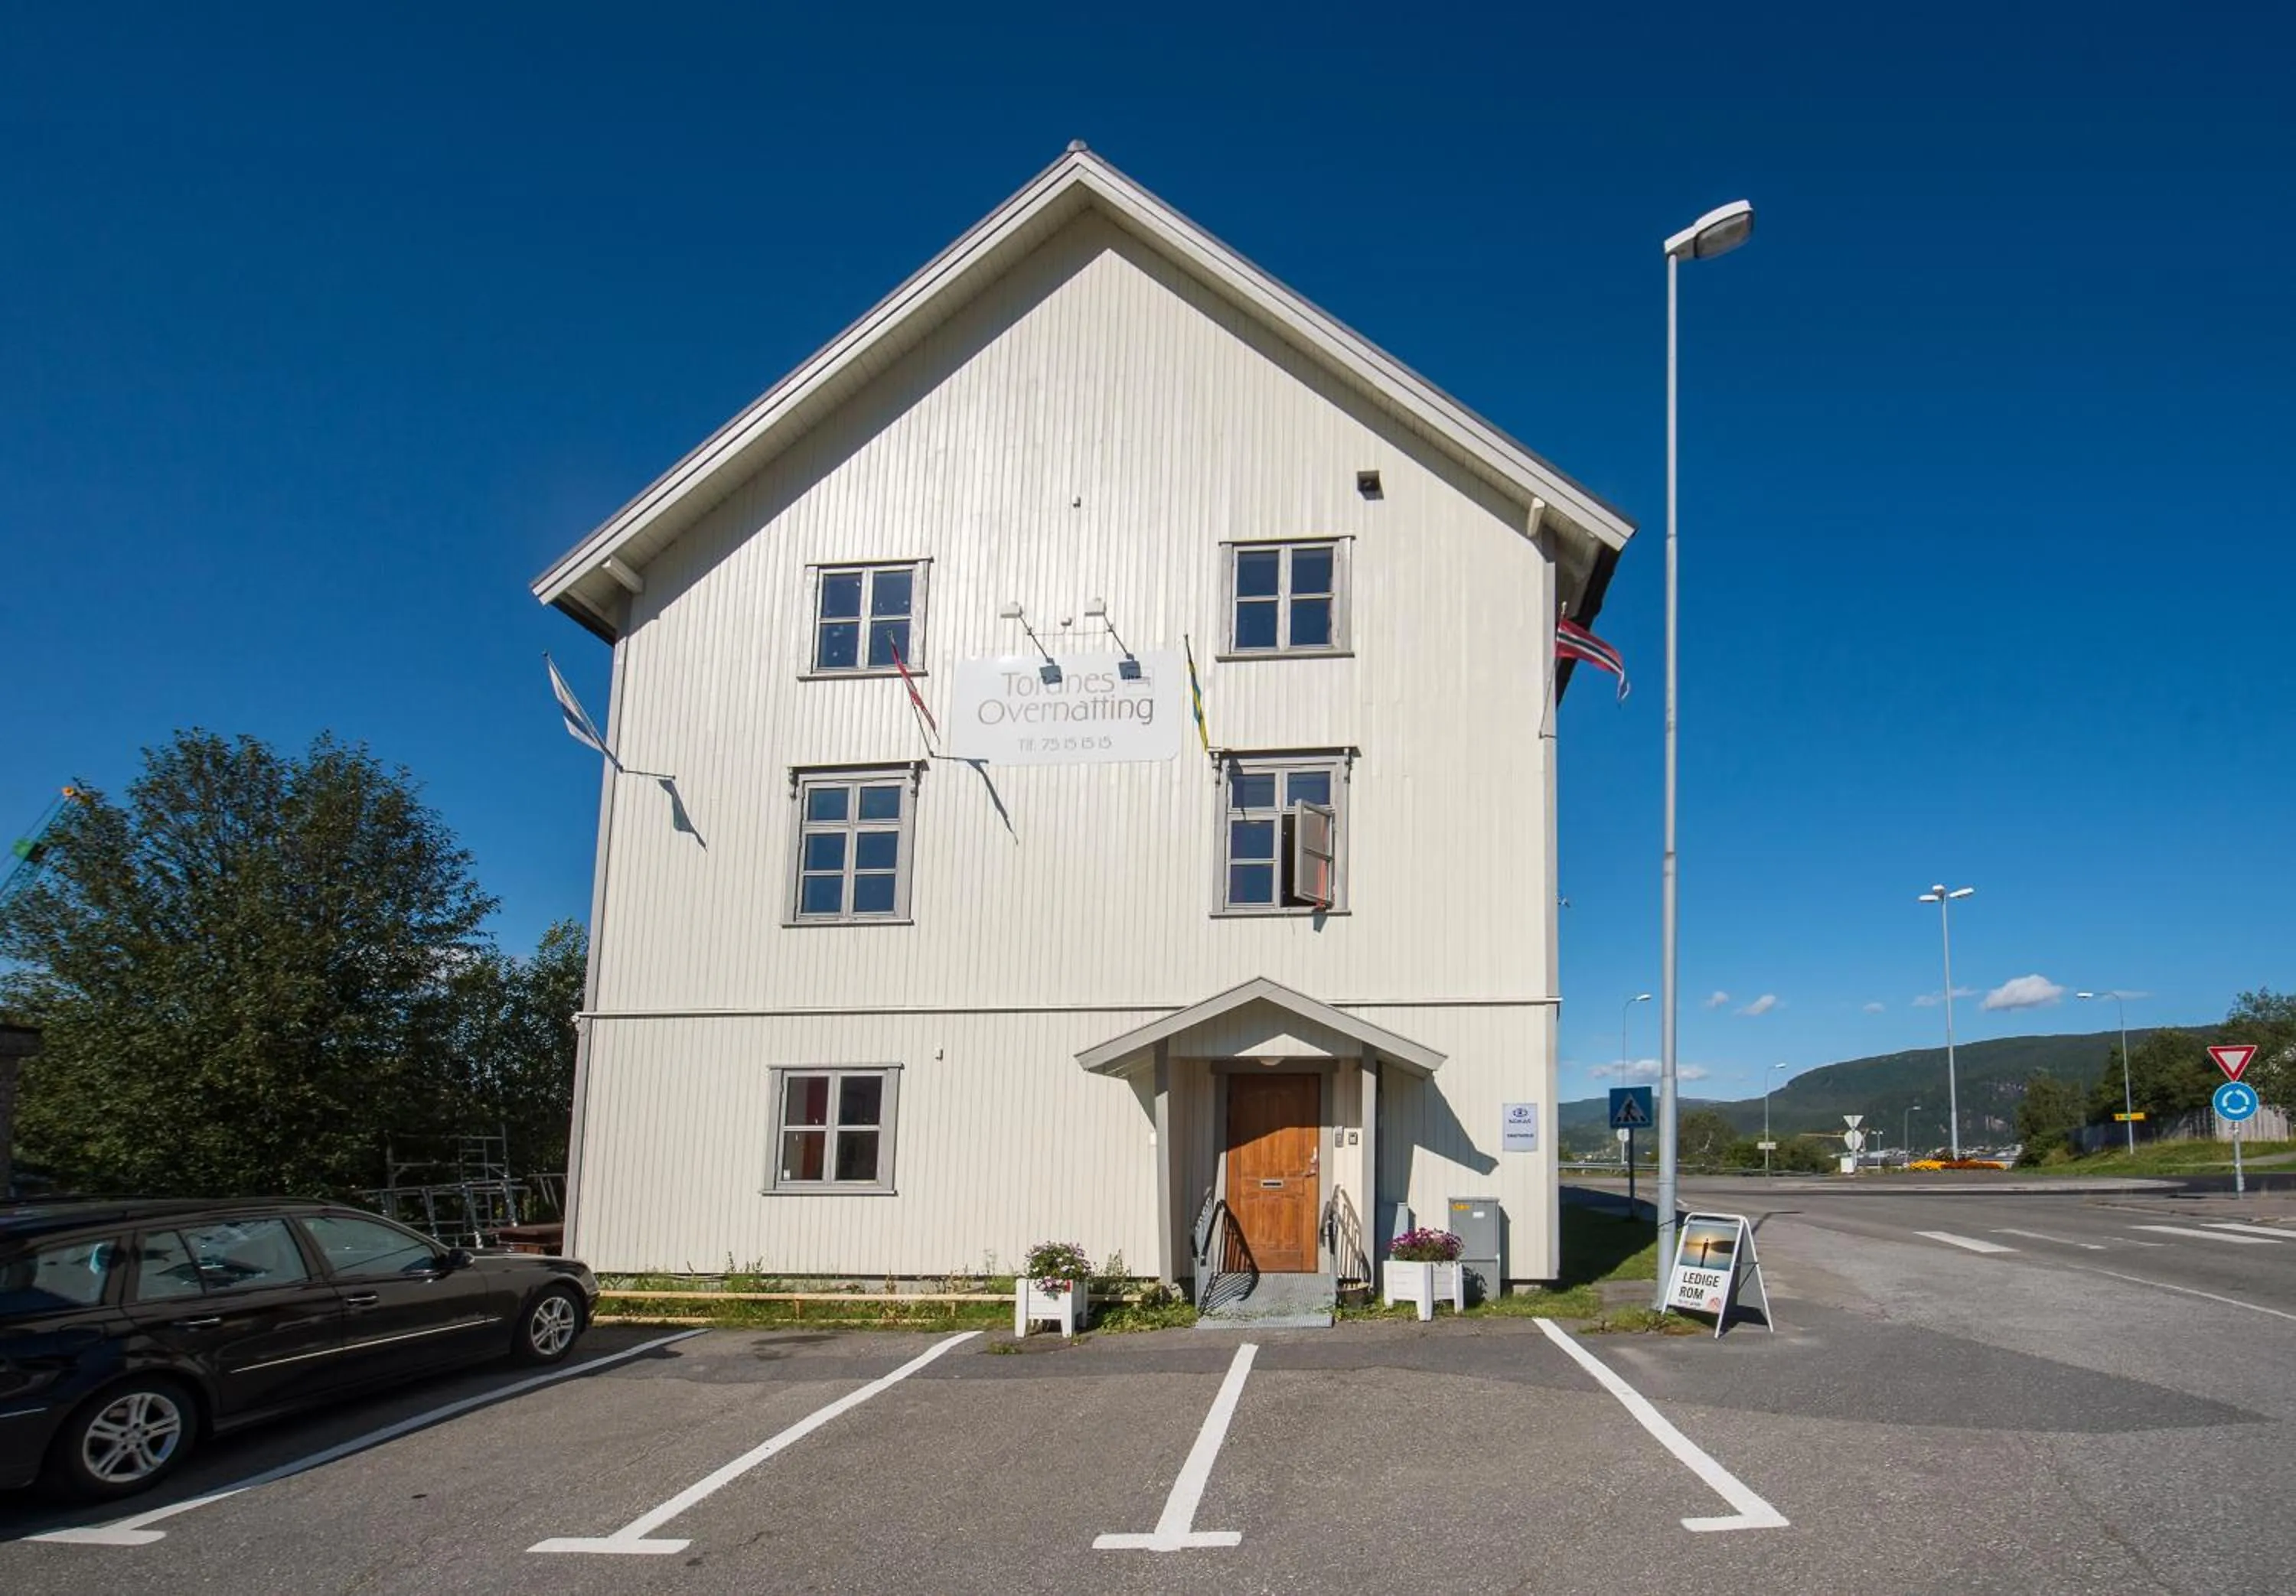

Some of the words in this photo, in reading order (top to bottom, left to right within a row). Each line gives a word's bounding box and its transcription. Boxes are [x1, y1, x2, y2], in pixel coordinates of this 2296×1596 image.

[978, 695, 1153, 725] Overnatting
[1683, 1272, 1719, 1287] LEDIGE
[1679, 1287, 1704, 1299] ROM
